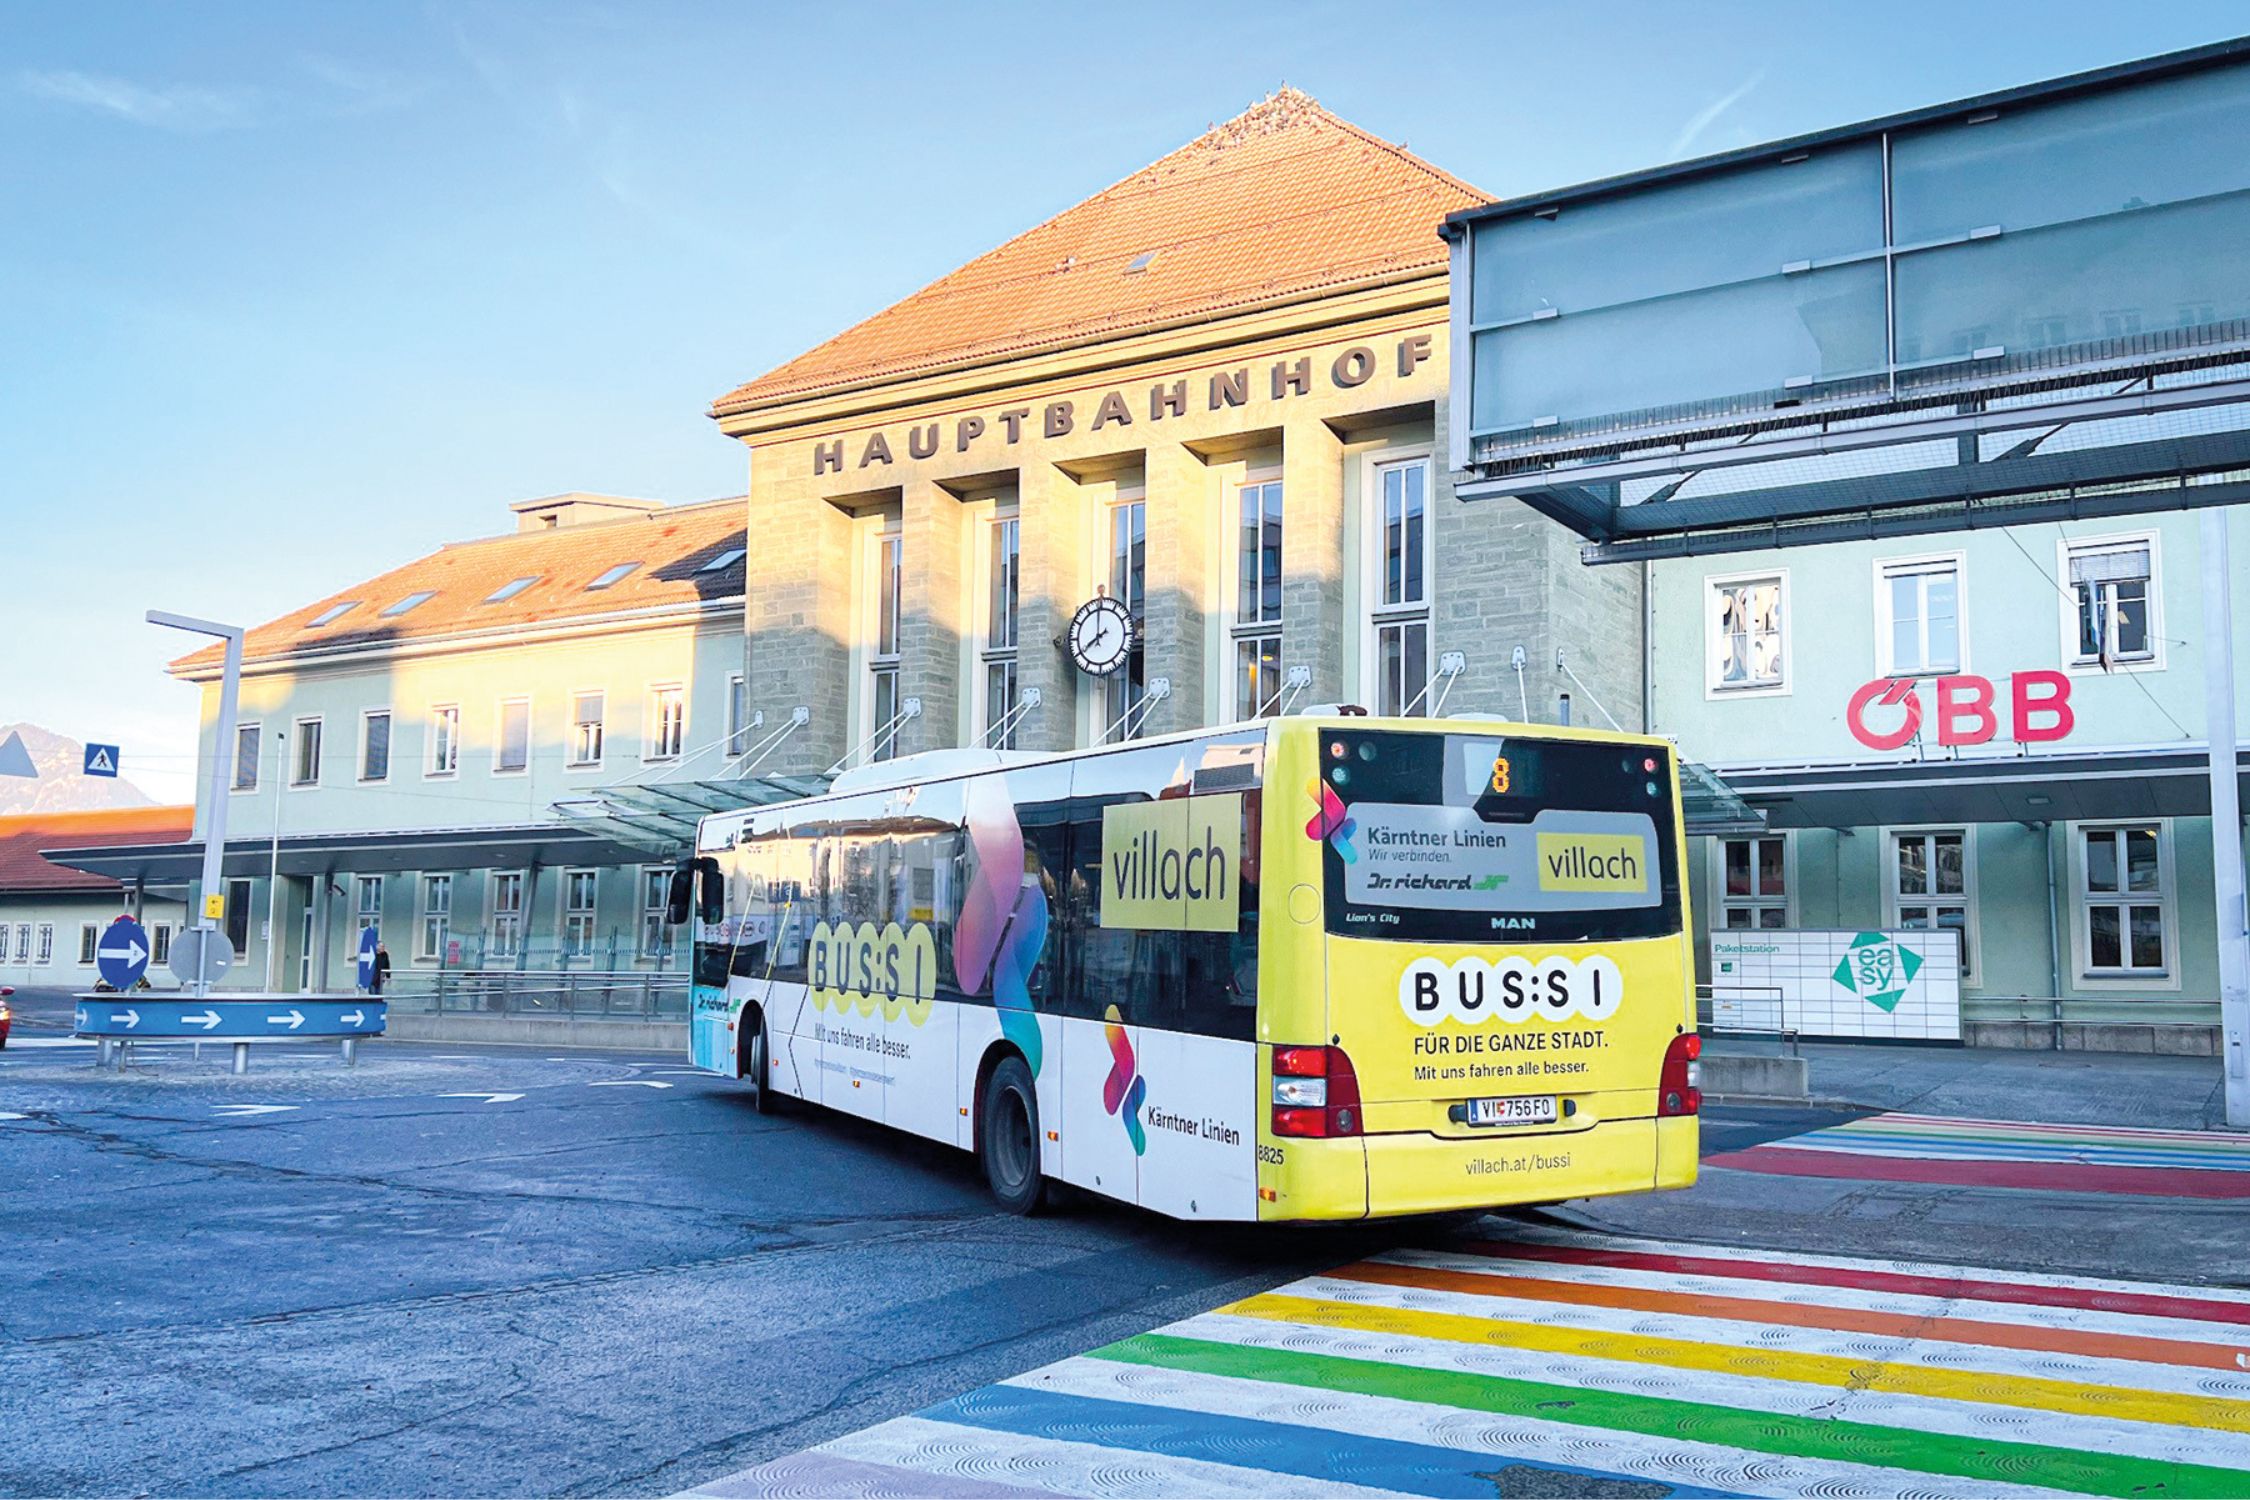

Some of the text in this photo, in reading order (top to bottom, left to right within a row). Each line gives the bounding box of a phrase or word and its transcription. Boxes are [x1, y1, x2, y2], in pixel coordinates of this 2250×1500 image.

[814, 333, 1432, 475] HAUPTBAHNHOF
[1847, 670, 2074, 751] ÖBB
[1492, 757, 1510, 793] 8
[1368, 826, 1506, 848] Kärntner Linien
[1113, 826, 1225, 900] villach
[1368, 849, 1388, 861] Wir
[1548, 846, 1637, 879] villach
[1394, 873, 1472, 890] richard
[1345, 912, 1400, 925] Lion's City
[1490, 917, 1536, 930] MAN
[1714, 943, 1780, 954] Paketstation
[827, 1030, 840, 1045] uns
[841, 1027, 865, 1050] fahren
[866, 1032, 881, 1053] alle
[882, 1034, 911, 1060] besser.
[1414, 1031, 1608, 1055] FÜR DIE GANZE STADT.
[1414, 1061, 1589, 1080] Mit uns fahren alle besser.
[1148, 1106, 1240, 1146] Kärntner Linien
[1465, 1151, 1571, 1175] villach.at/bussi
